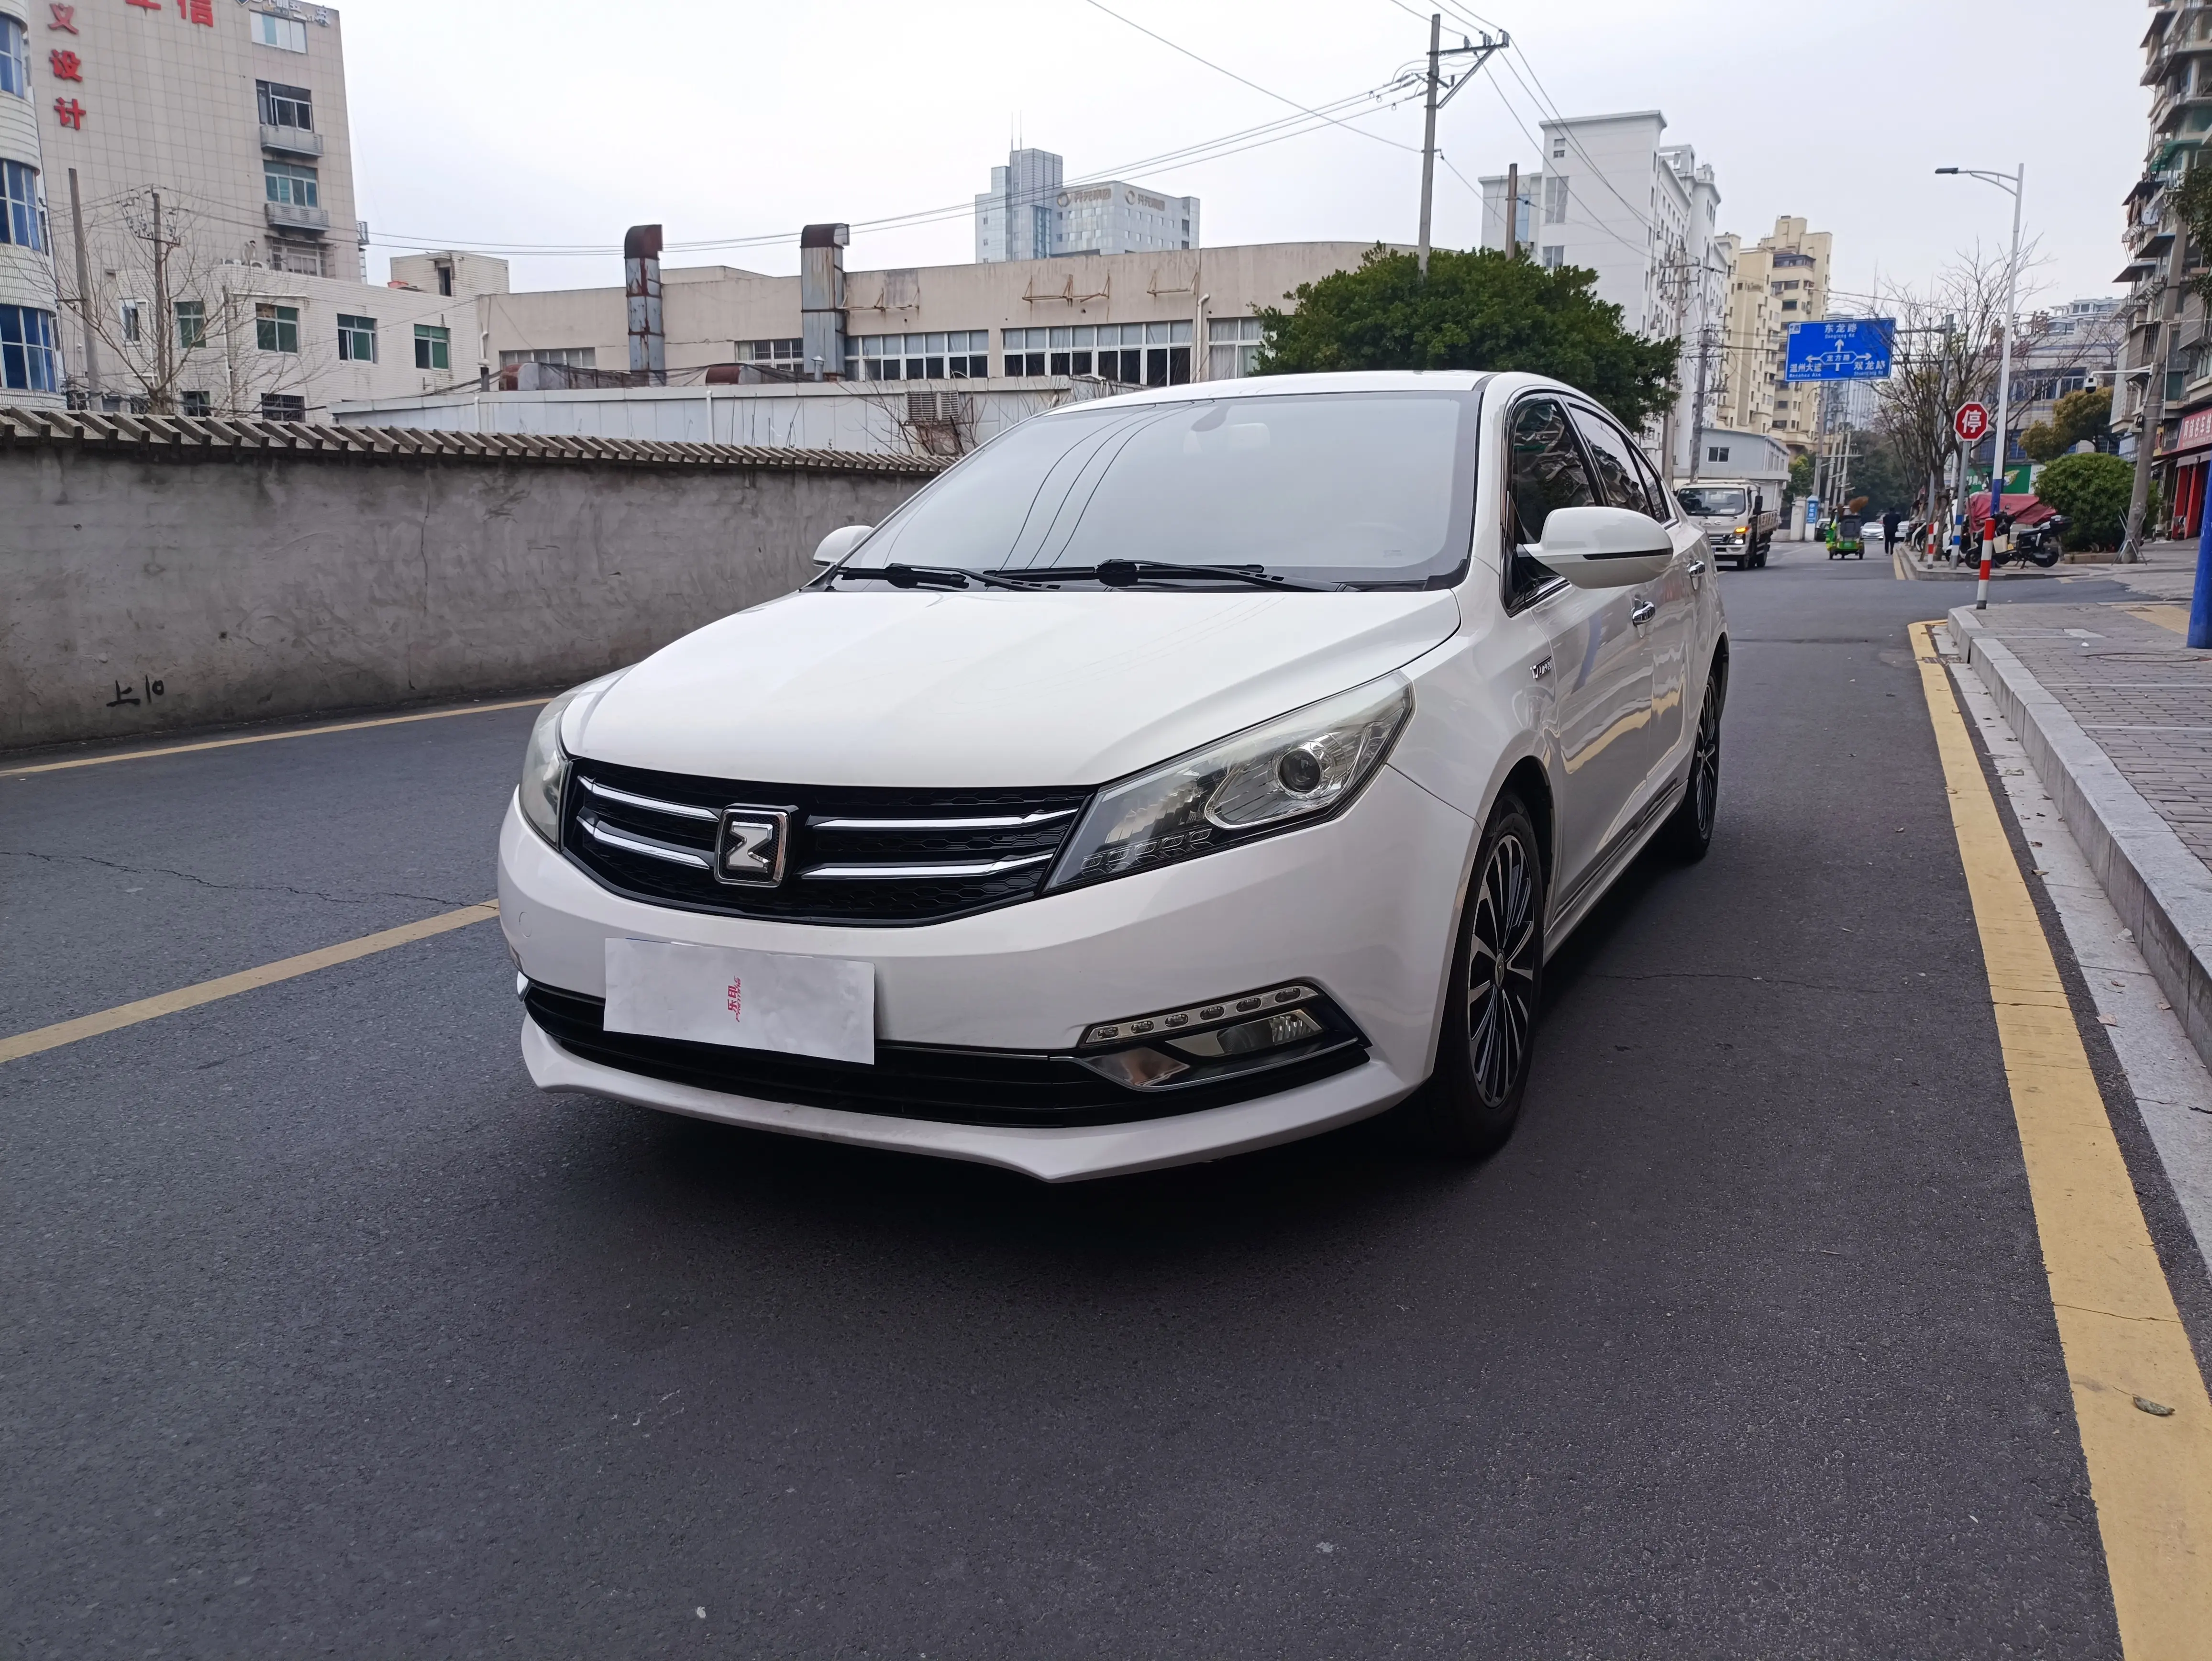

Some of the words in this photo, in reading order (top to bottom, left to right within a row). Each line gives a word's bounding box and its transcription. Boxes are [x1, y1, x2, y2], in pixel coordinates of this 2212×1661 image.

[1824, 323, 1857, 333] 东龙路
[1962, 410, 1982, 433] 停
